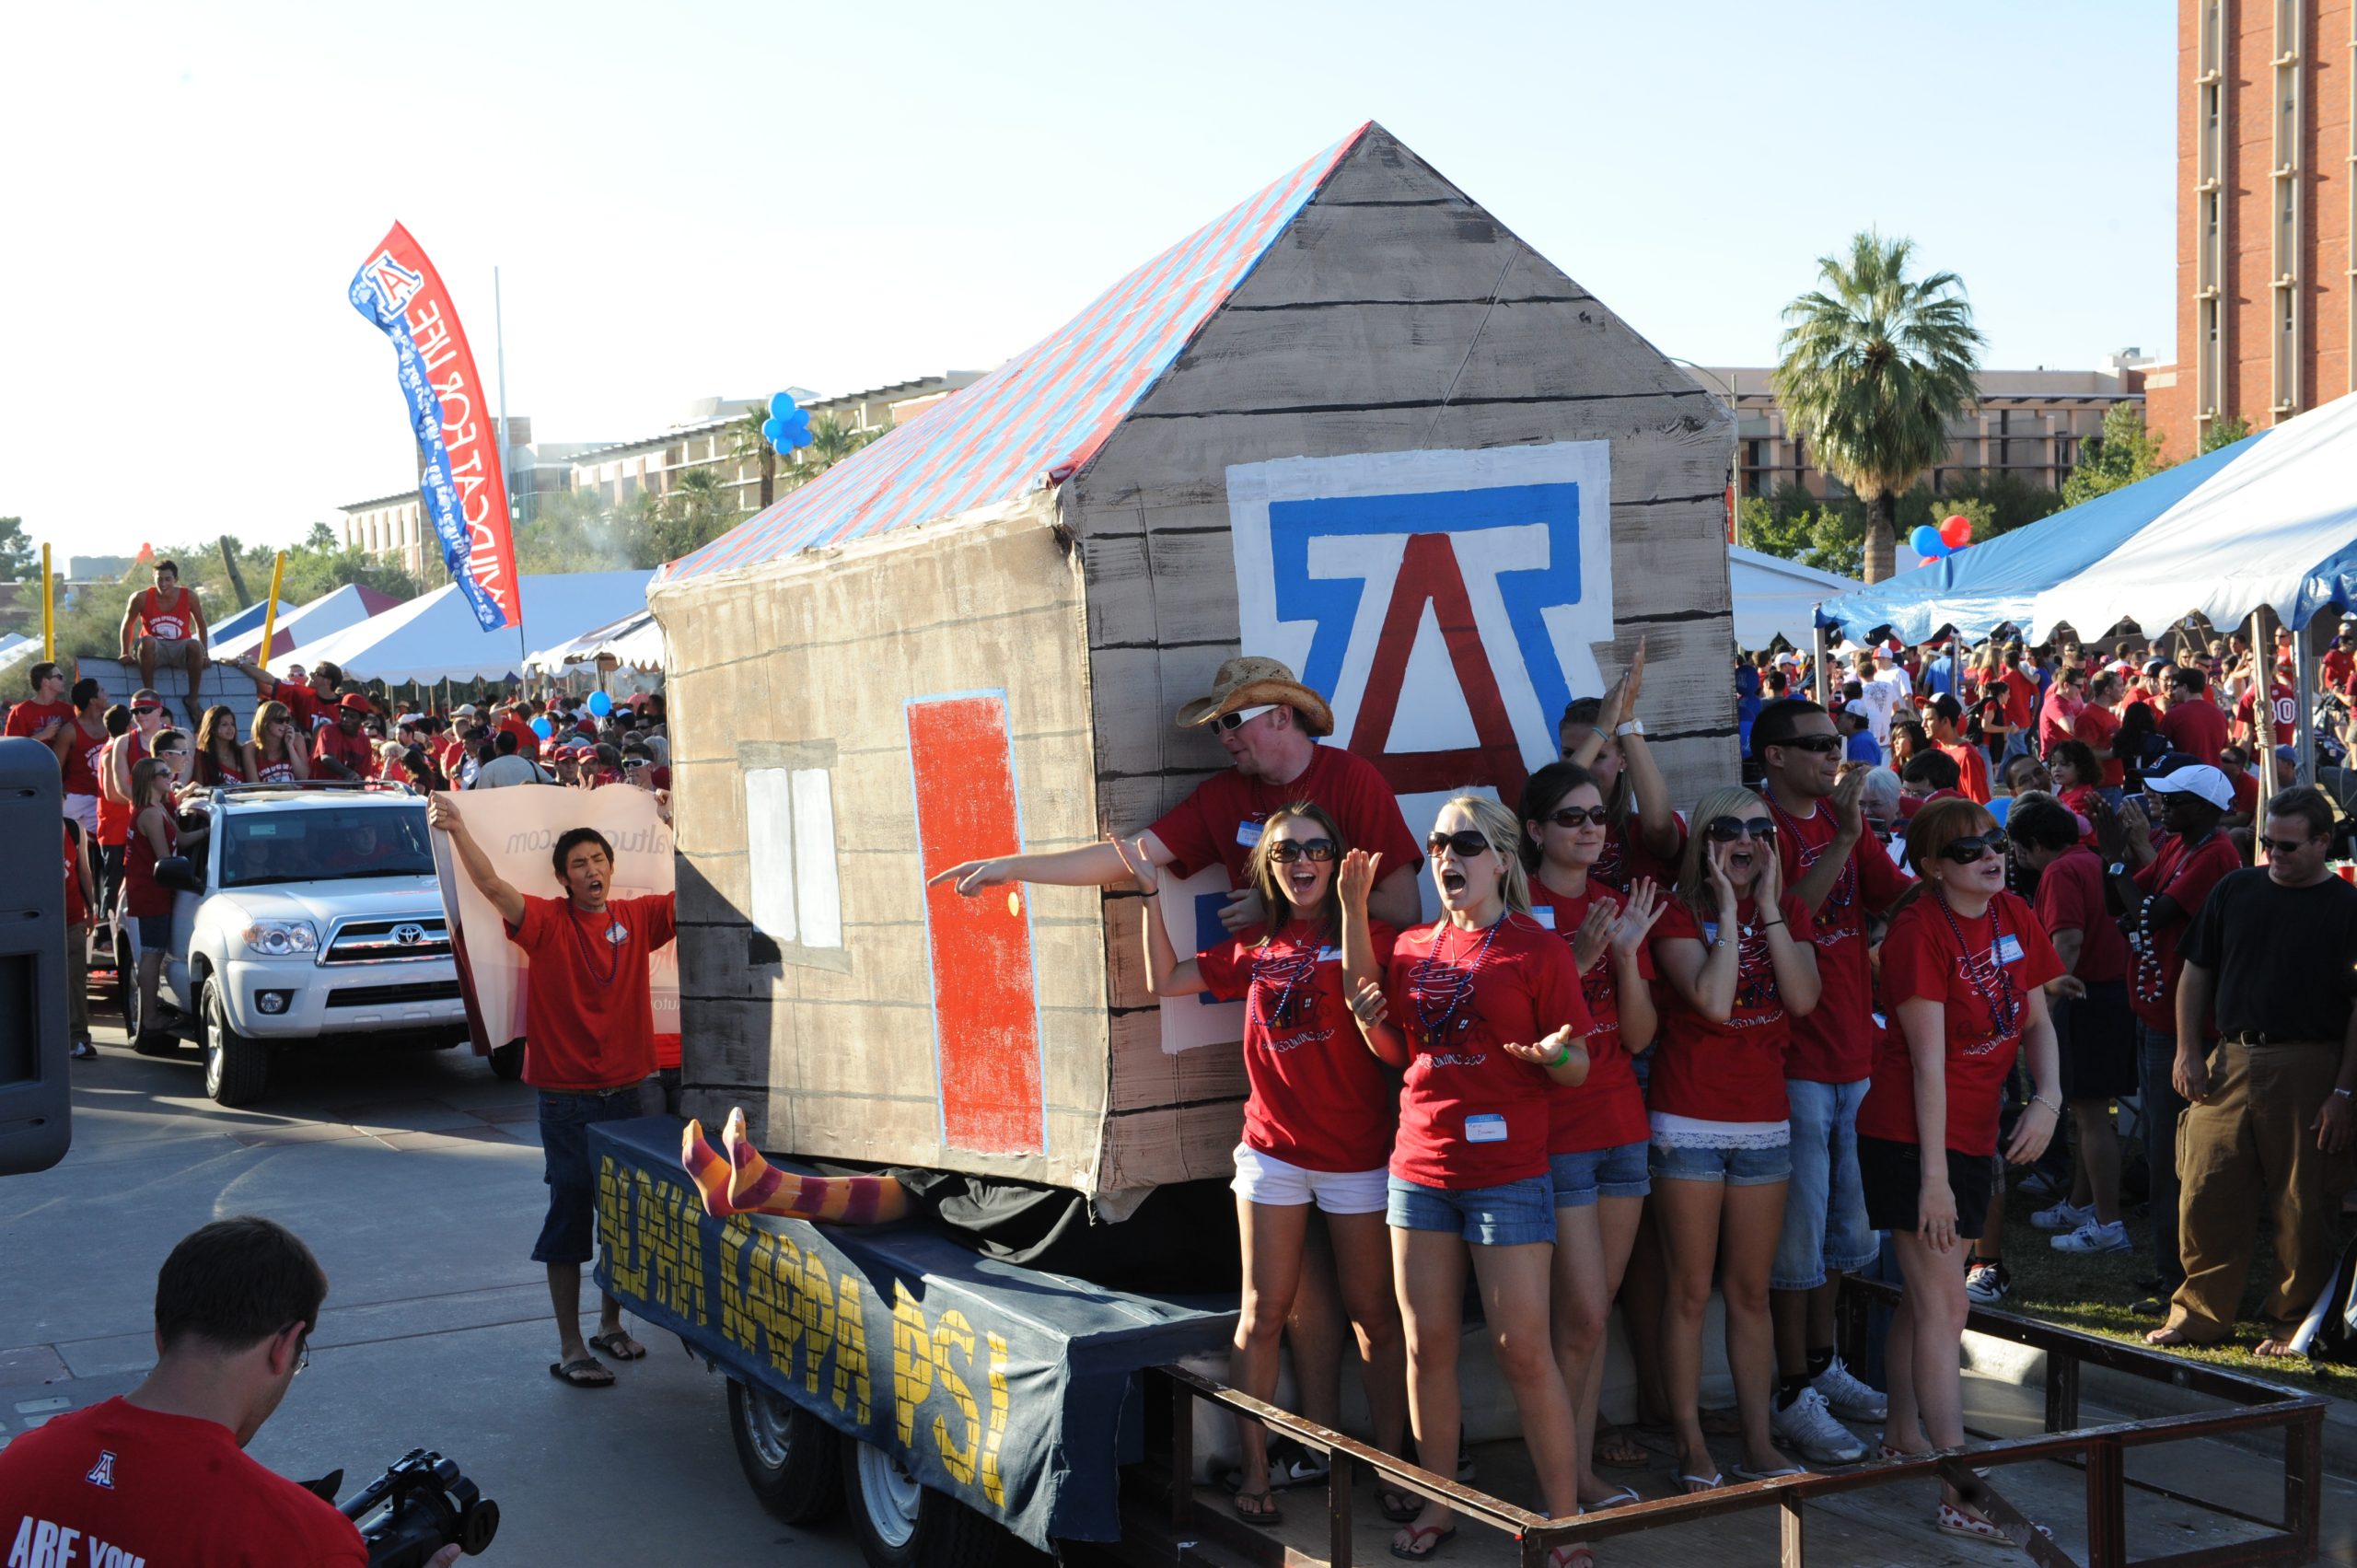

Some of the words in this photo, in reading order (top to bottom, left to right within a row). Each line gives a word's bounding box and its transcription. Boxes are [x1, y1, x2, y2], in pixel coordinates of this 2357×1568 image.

[598, 1155, 708, 1327] ALPHA
[719, 1213, 872, 1425] KAPPA
[892, 1276, 1010, 1510] PSI
[6, 1515, 81, 1568] ARE
